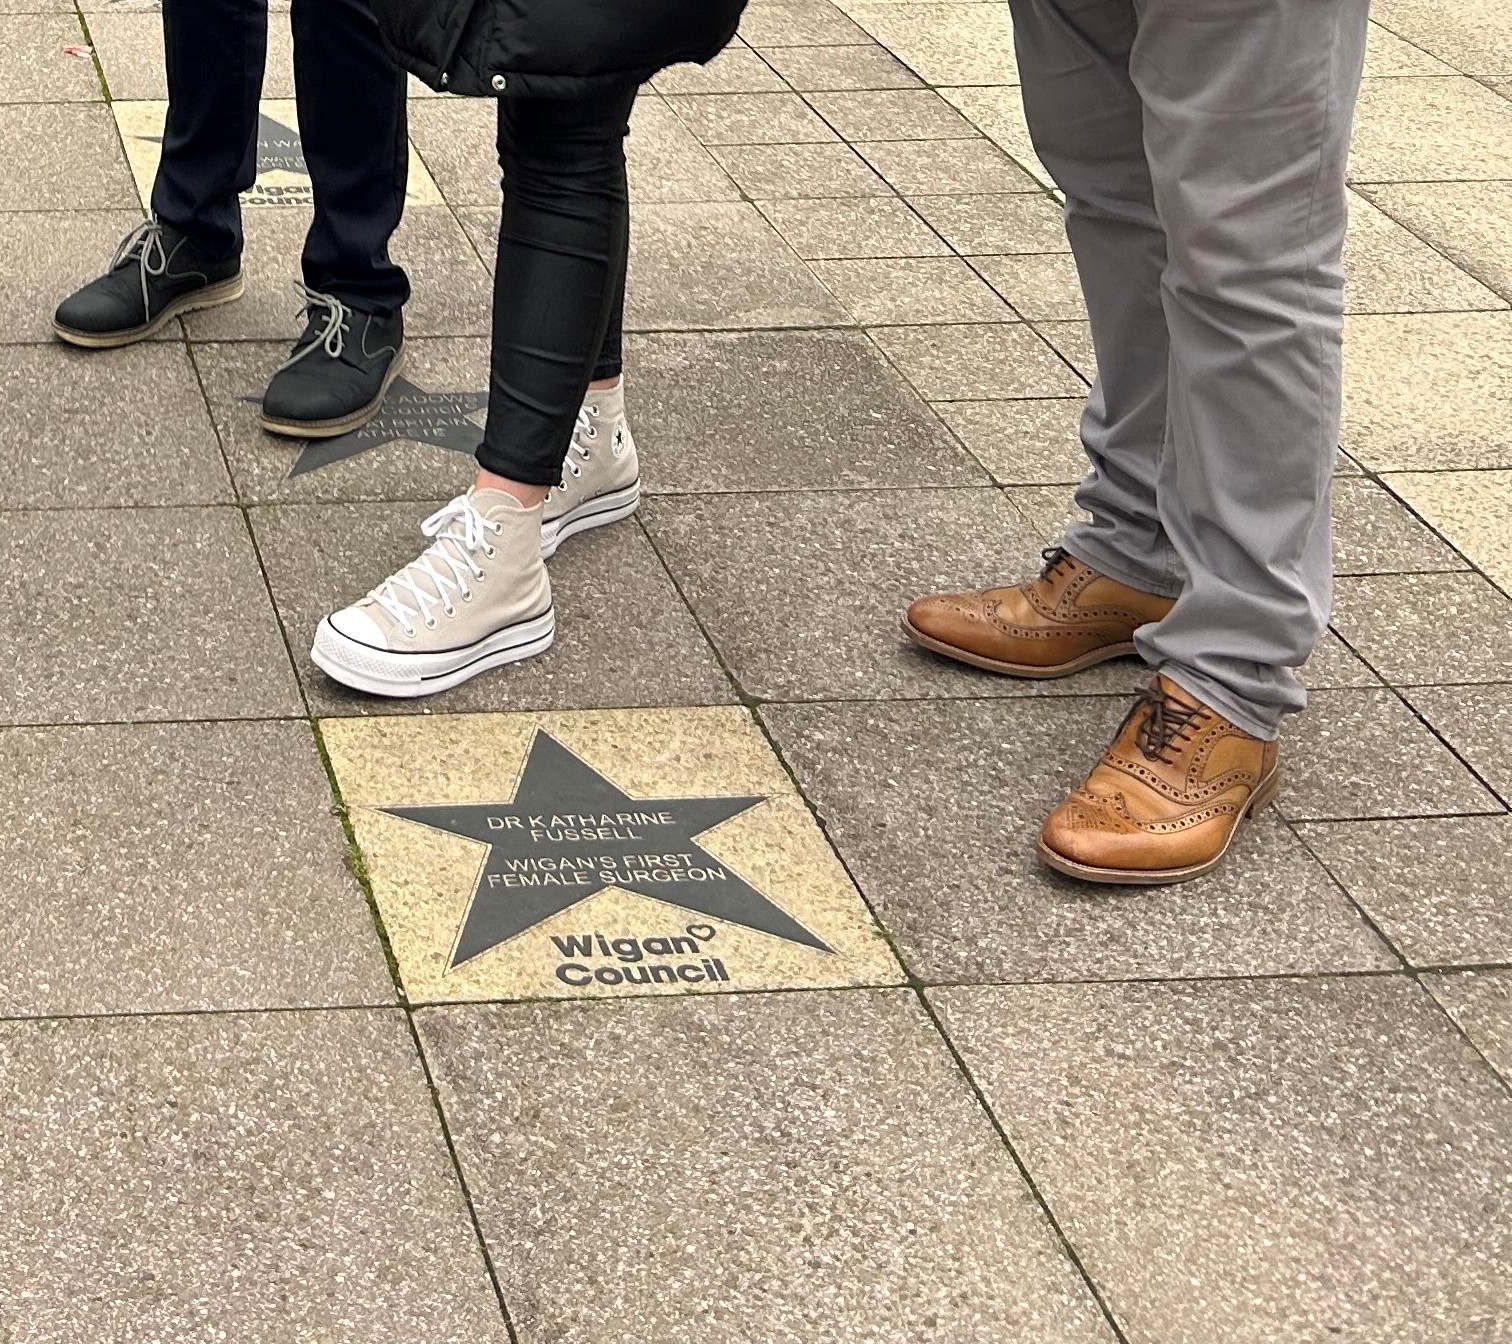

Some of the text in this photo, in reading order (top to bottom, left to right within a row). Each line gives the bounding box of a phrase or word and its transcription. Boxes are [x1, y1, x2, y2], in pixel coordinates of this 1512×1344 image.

[487, 810, 677, 832] DR KATHARINE
[530, 826, 643, 843] FUSSELL
[504, 852, 694, 872] WIGAN'S FIRST
[487, 866, 727, 889] FEMALE SURGEON
[550, 932, 701, 963] Wigan
[554, 957, 731, 987] Council
